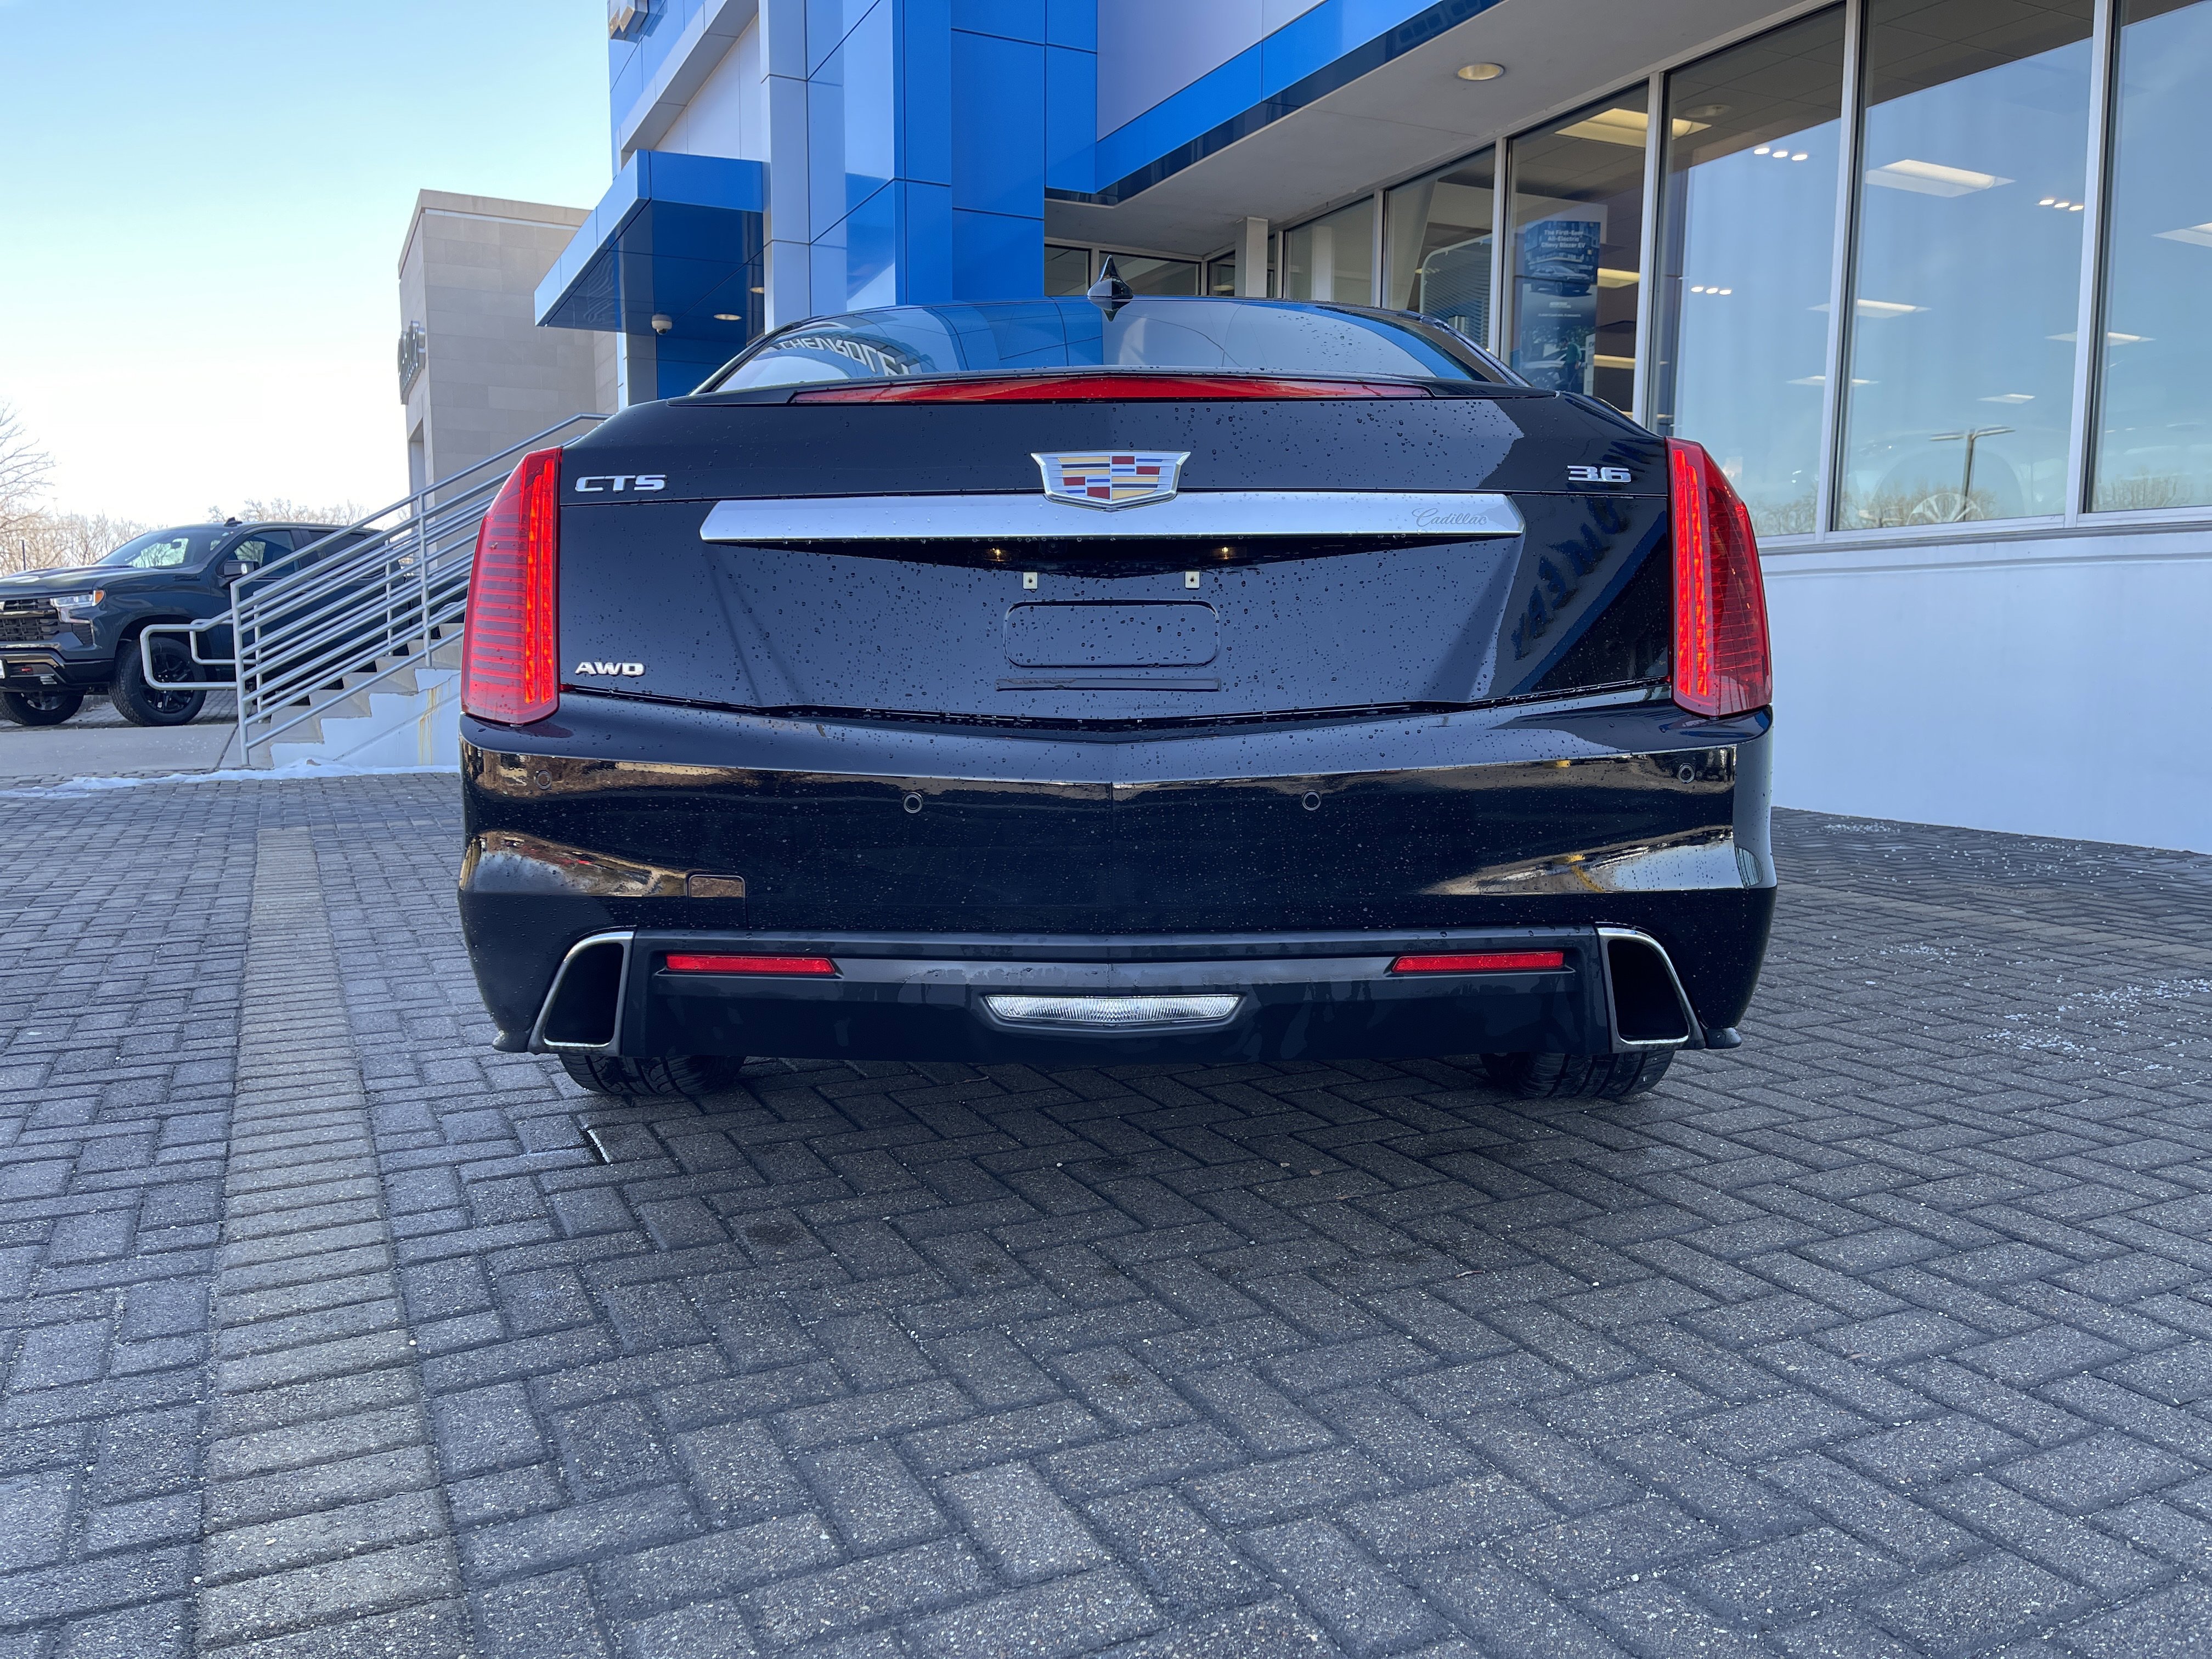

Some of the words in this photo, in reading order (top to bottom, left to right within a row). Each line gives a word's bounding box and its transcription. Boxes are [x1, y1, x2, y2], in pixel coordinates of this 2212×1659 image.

[575, 475, 666, 492] CTS
[1412, 507, 1487, 527] Cadillac
[575, 662, 644, 675] AWD
